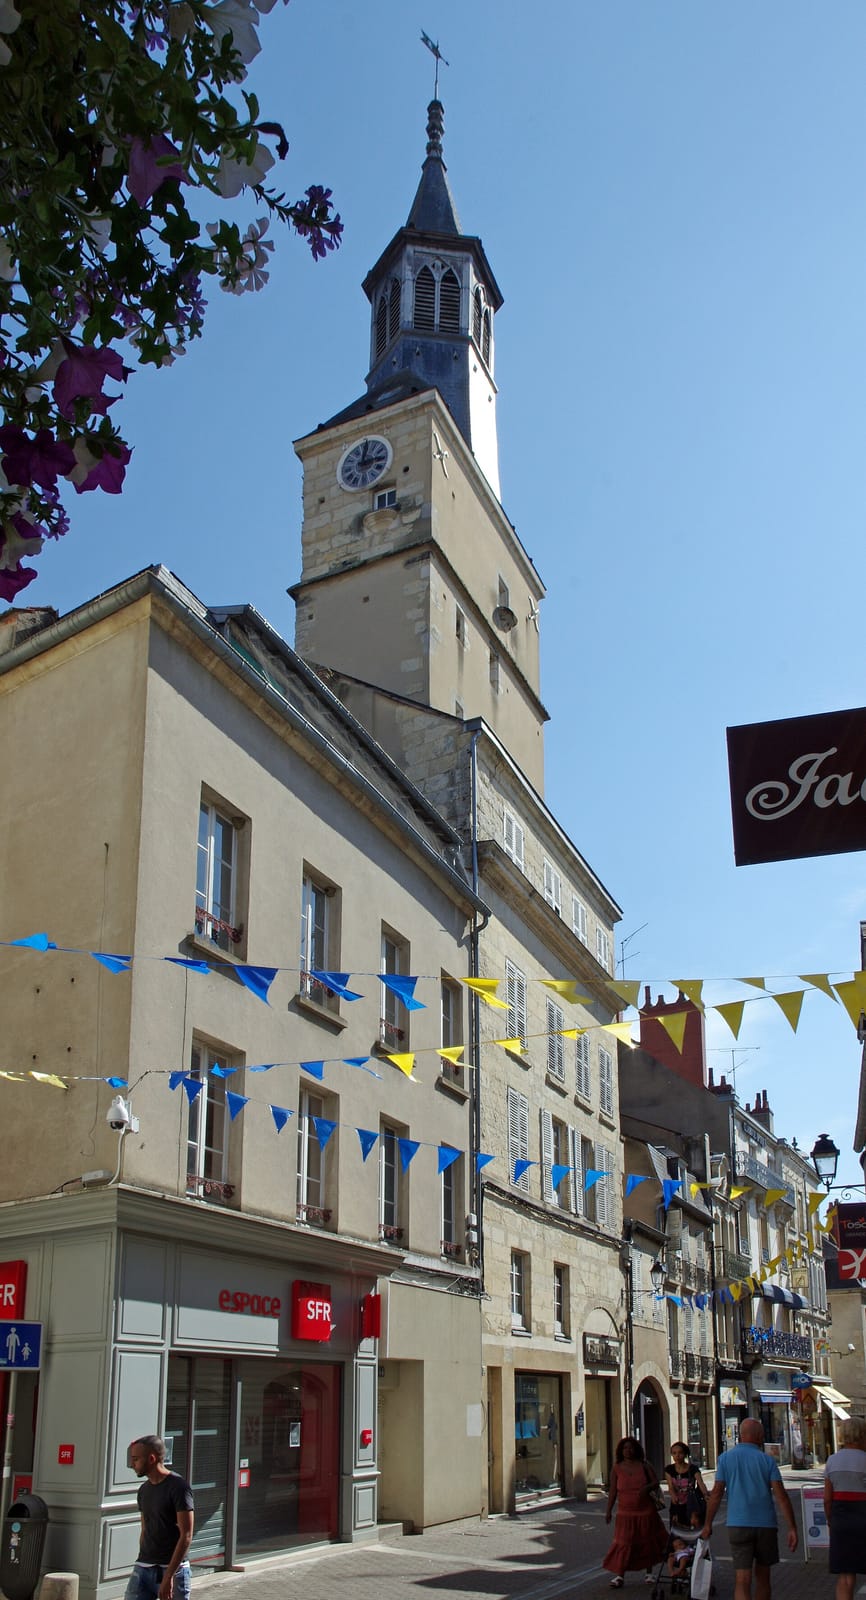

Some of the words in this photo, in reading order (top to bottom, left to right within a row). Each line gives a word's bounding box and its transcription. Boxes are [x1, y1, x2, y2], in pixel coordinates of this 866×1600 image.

[745, 747, 866, 821] Ja
[219, 1289, 281, 1318] espace
[307, 1300, 331, 1322] SFR
